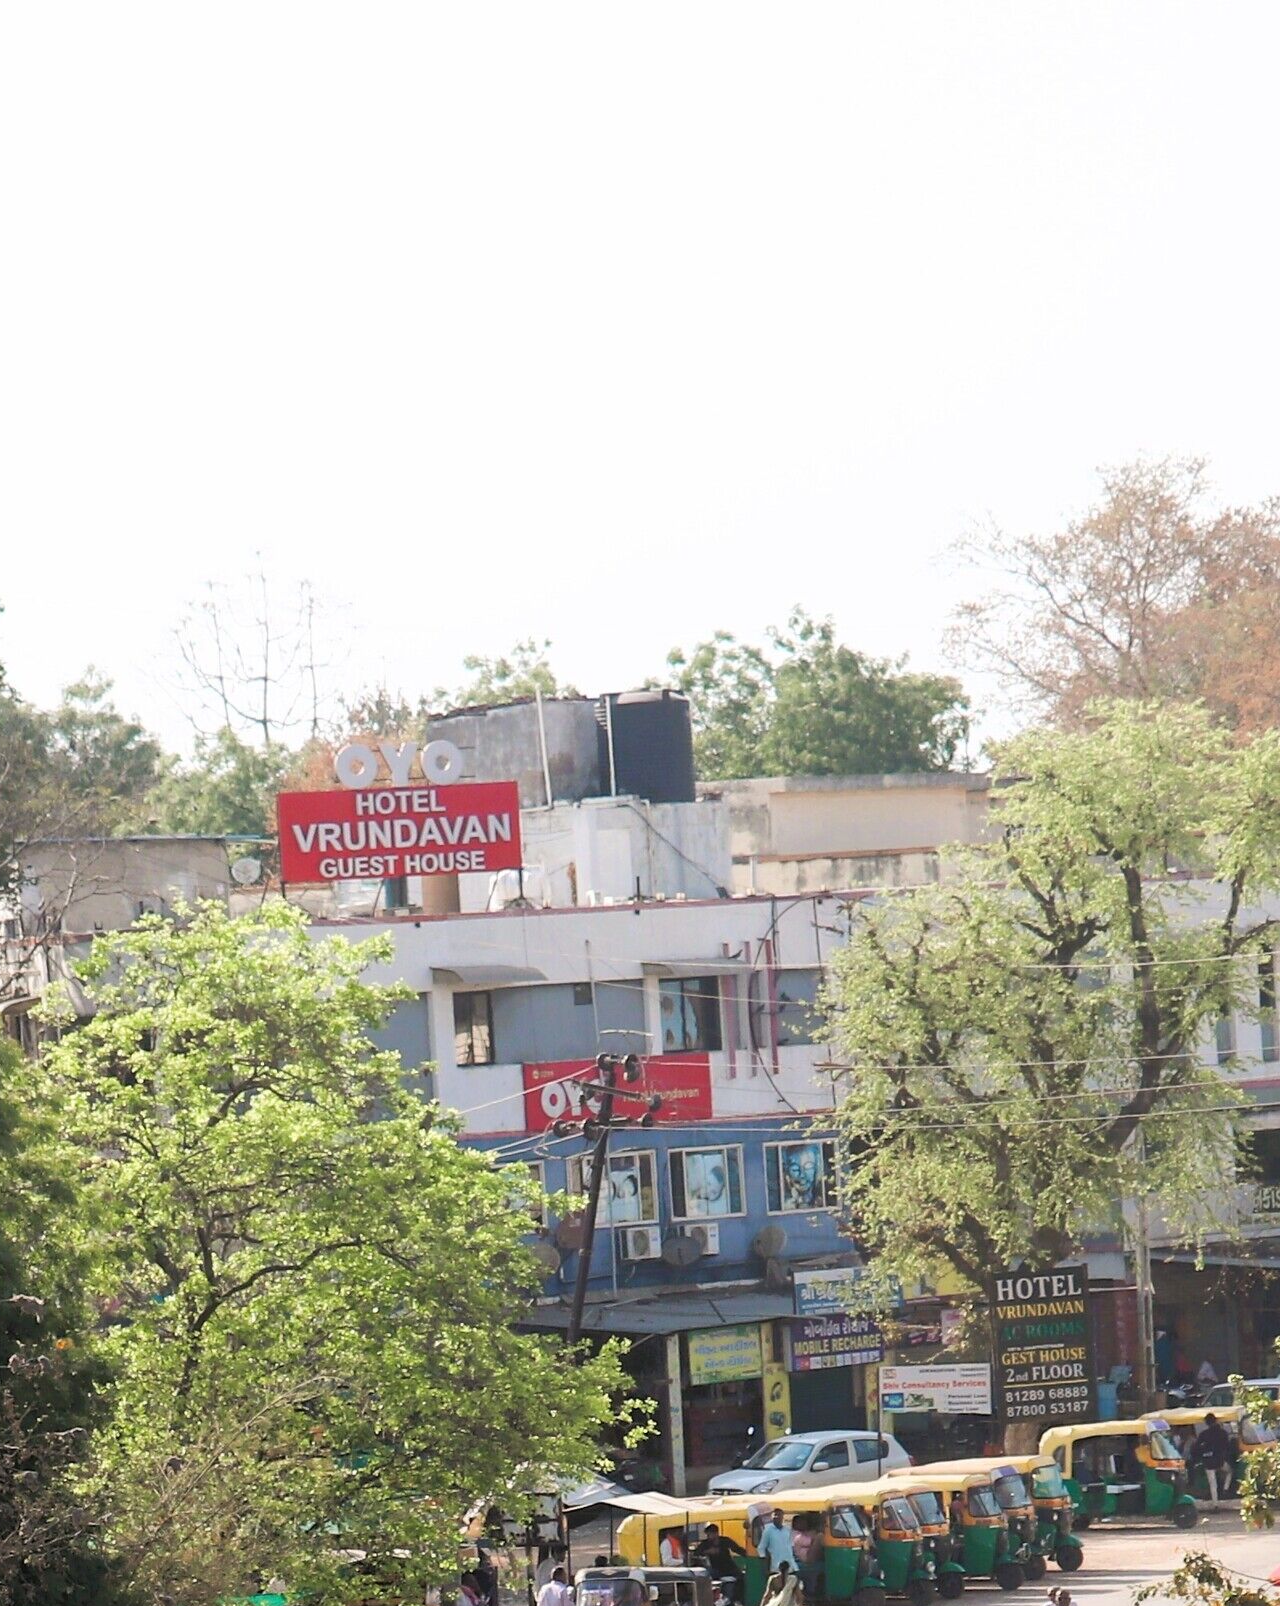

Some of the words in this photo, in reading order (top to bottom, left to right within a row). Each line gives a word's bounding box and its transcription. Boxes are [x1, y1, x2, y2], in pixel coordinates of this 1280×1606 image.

[334, 740, 464, 788] OYO
[355, 789, 447, 816] HOTEL
[292, 813, 511, 853] VRUNDAVAN
[320, 855, 400, 878] GUEST
[404, 850, 486, 874] HOUSE
[996, 1275, 1082, 1301] HOTEL
[996, 1300, 1084, 1320] VRUNDAVAN
[1026, 1319, 1085, 1338] ROOMS
[794, 1338, 830, 1355] MOBILE
[832, 1333, 881, 1352] RECHARGE
[1001, 1350, 1035, 1366] GEST
[1040, 1347, 1086, 1364] HOUSE
[1006, 1368, 1029, 1383] 2nd
[1032, 1363, 1084, 1381] FLOOR
[902, 1381, 950, 1389] Consultancy
[1006, 1388, 1046, 1403] 81289
[1048, 1385, 1088, 1400] 68889
[1006, 1404, 1047, 1418] 87800
[1050, 1401, 1089, 1416] 53187
